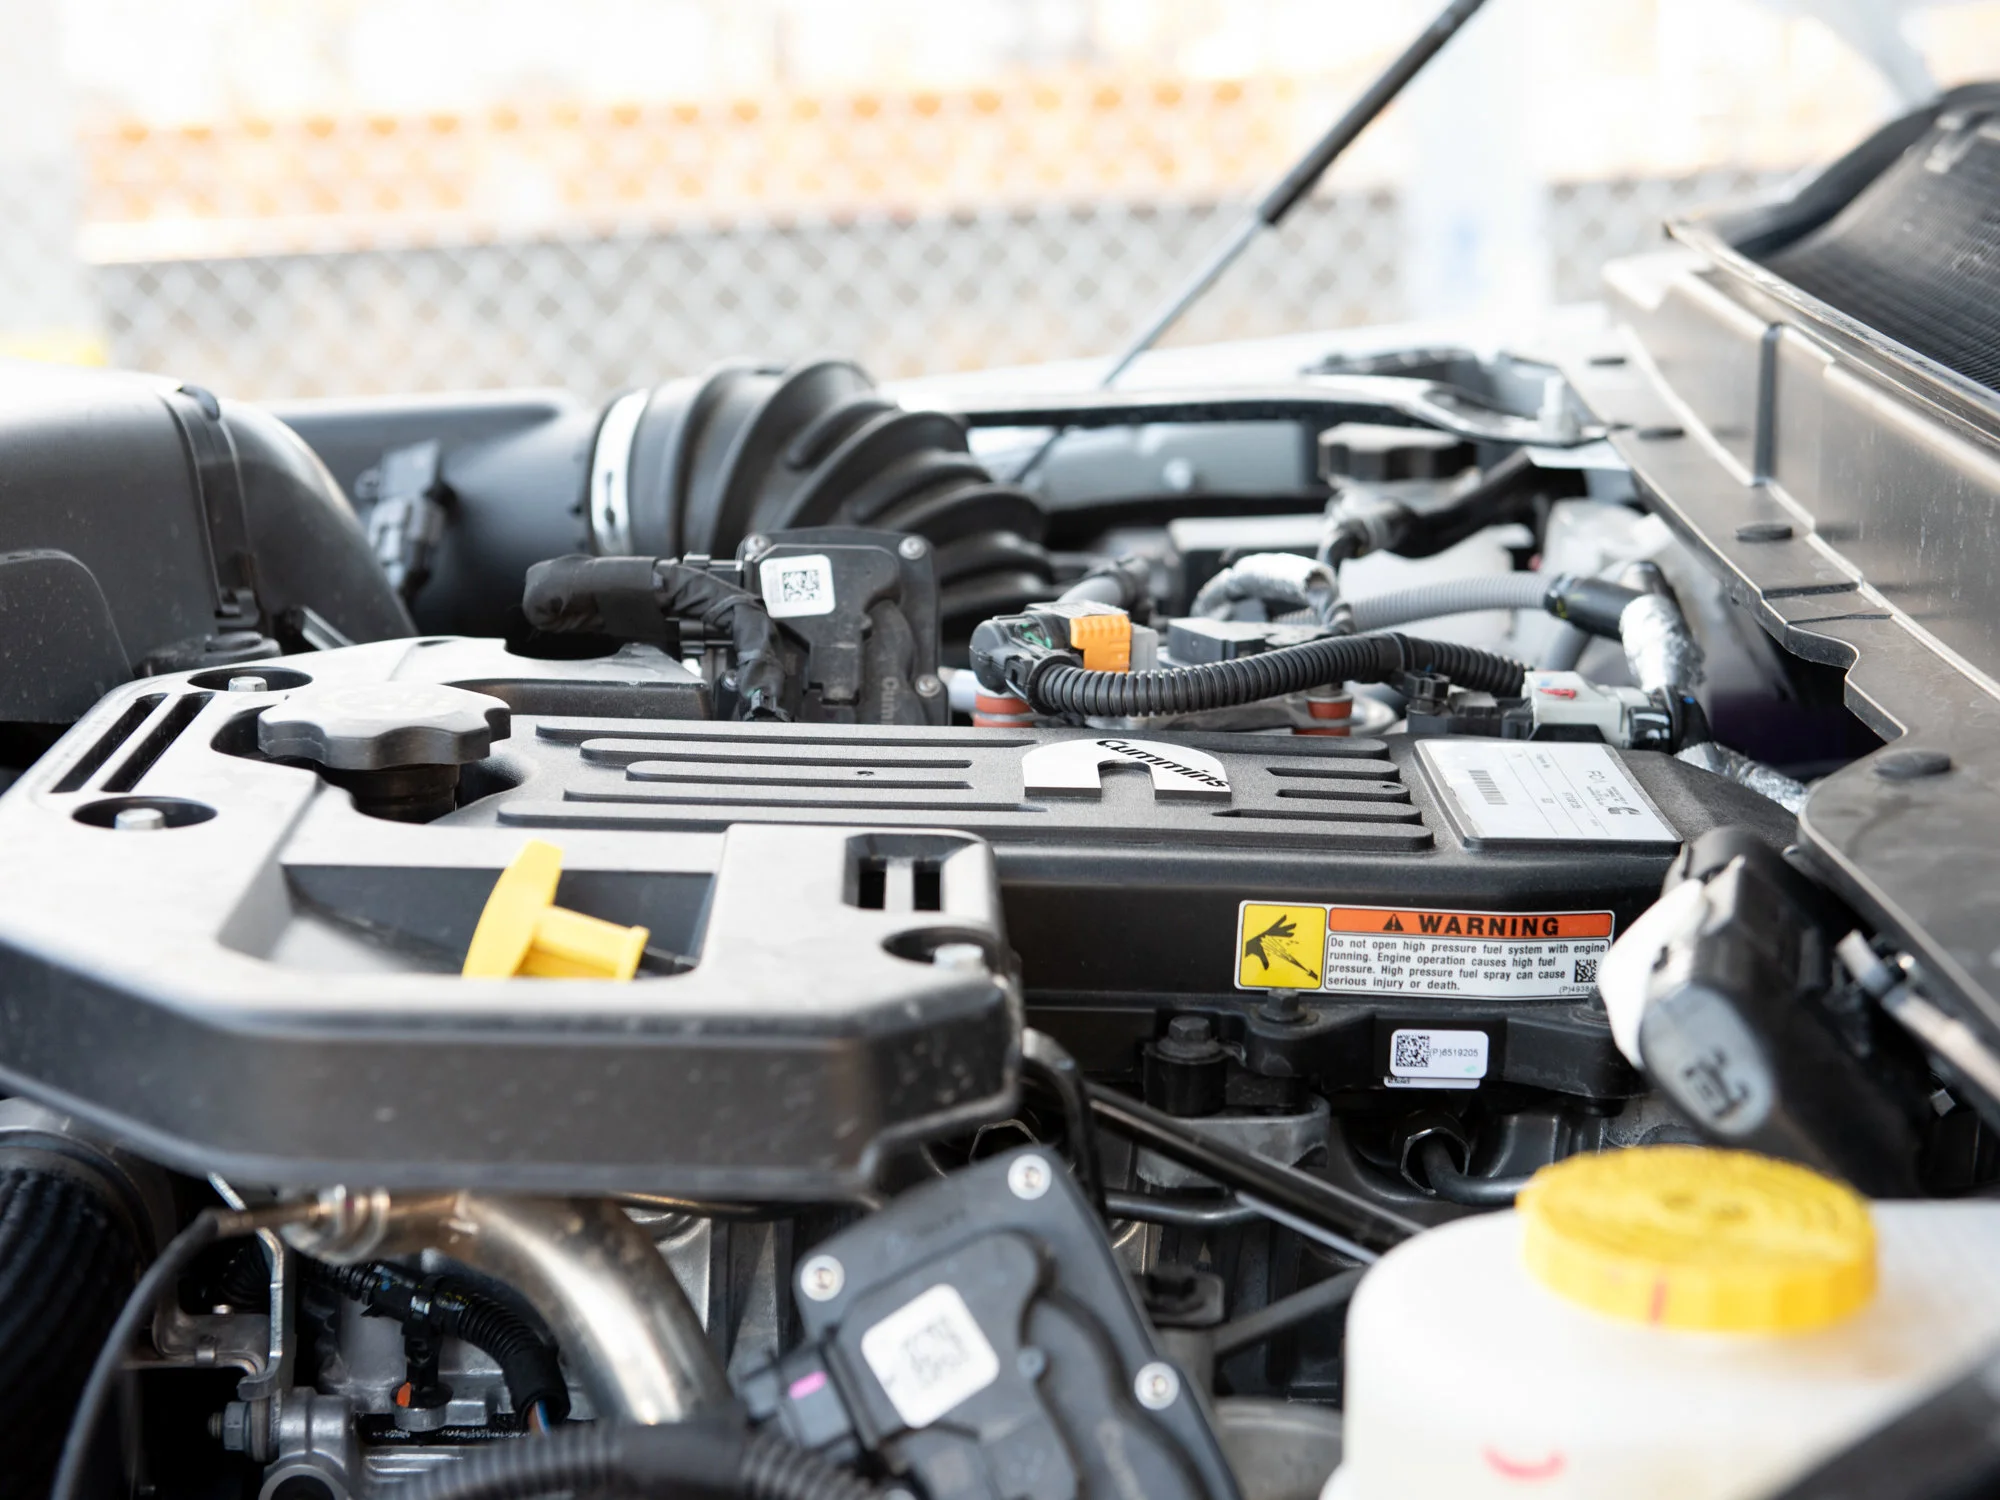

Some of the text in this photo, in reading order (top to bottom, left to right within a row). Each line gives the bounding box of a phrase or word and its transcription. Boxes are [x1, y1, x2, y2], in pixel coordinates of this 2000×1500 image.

[1096, 739, 1229, 788] Cummins
[1418, 914, 1559, 936] WARNING
[1330, 937, 1606, 955] Do not open high pressure fuel system with engine
[1329, 952, 1556, 969] running. Engine operation causes high fuel
[1328, 965, 1565, 981] pressure. High pressure fuel spray can cause
[1328, 976, 1460, 990] serious injury or death.
